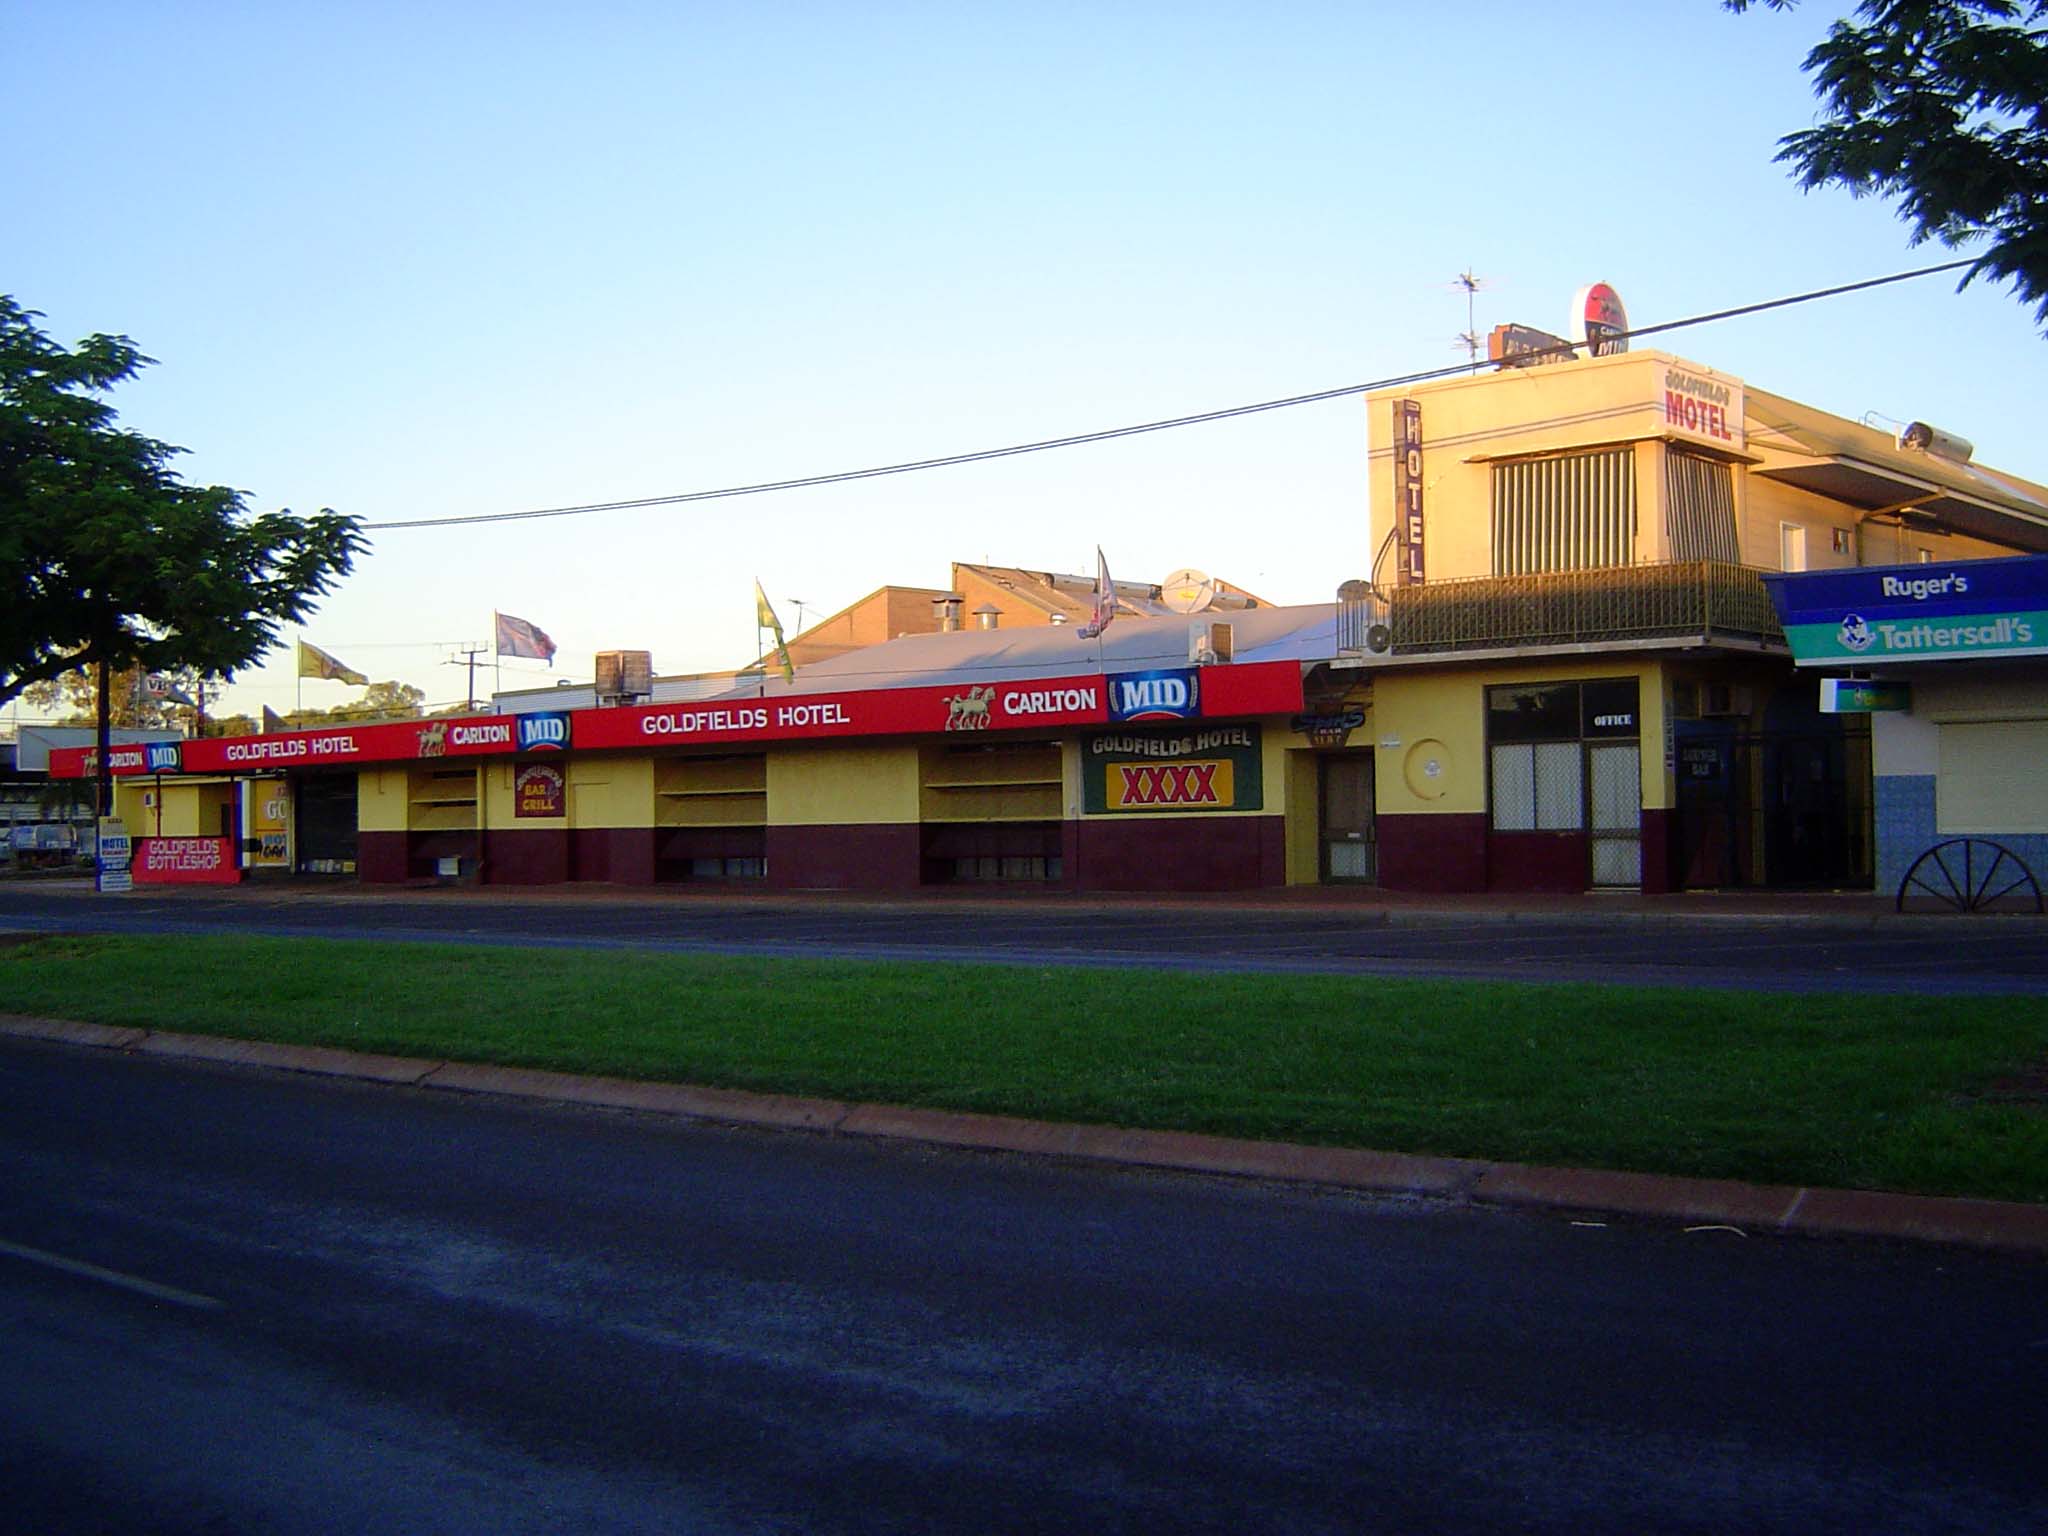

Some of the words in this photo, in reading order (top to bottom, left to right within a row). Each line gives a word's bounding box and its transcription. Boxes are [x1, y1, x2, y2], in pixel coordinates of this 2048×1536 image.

[1665, 390, 1732, 441] MOTEL
[1406, 414, 1423, 578] HOTEL
[1882, 573, 1968, 600] Ruger's
[1878, 617, 2033, 649] Tattersall's
[1003, 688, 1097, 715] CARLTON
[1121, 678, 1188, 713] MID
[524, 718, 565, 744] MID
[642, 709, 768, 734] GOLDFIELDS
[778, 703, 850, 726] HOTEL
[1594, 714, 1632, 727] OFFICE
[453, 724, 510, 745] CARLTON
[1092, 736, 1194, 757] GOLDFIELDS
[1197, 727, 1252, 751] HOTEL
[109, 751, 143, 767] ARLTON
[151, 747, 177, 768] MID
[226, 739, 307, 760] GOLDFIELDS
[312, 736, 359, 754] HOTEL
[1120, 763, 1219, 806] XXXX
[522, 798, 556, 811] GRILL
[149, 840, 219, 854] GOLDFIELDS
[147, 855, 221, 870] BOTTLESHOP
